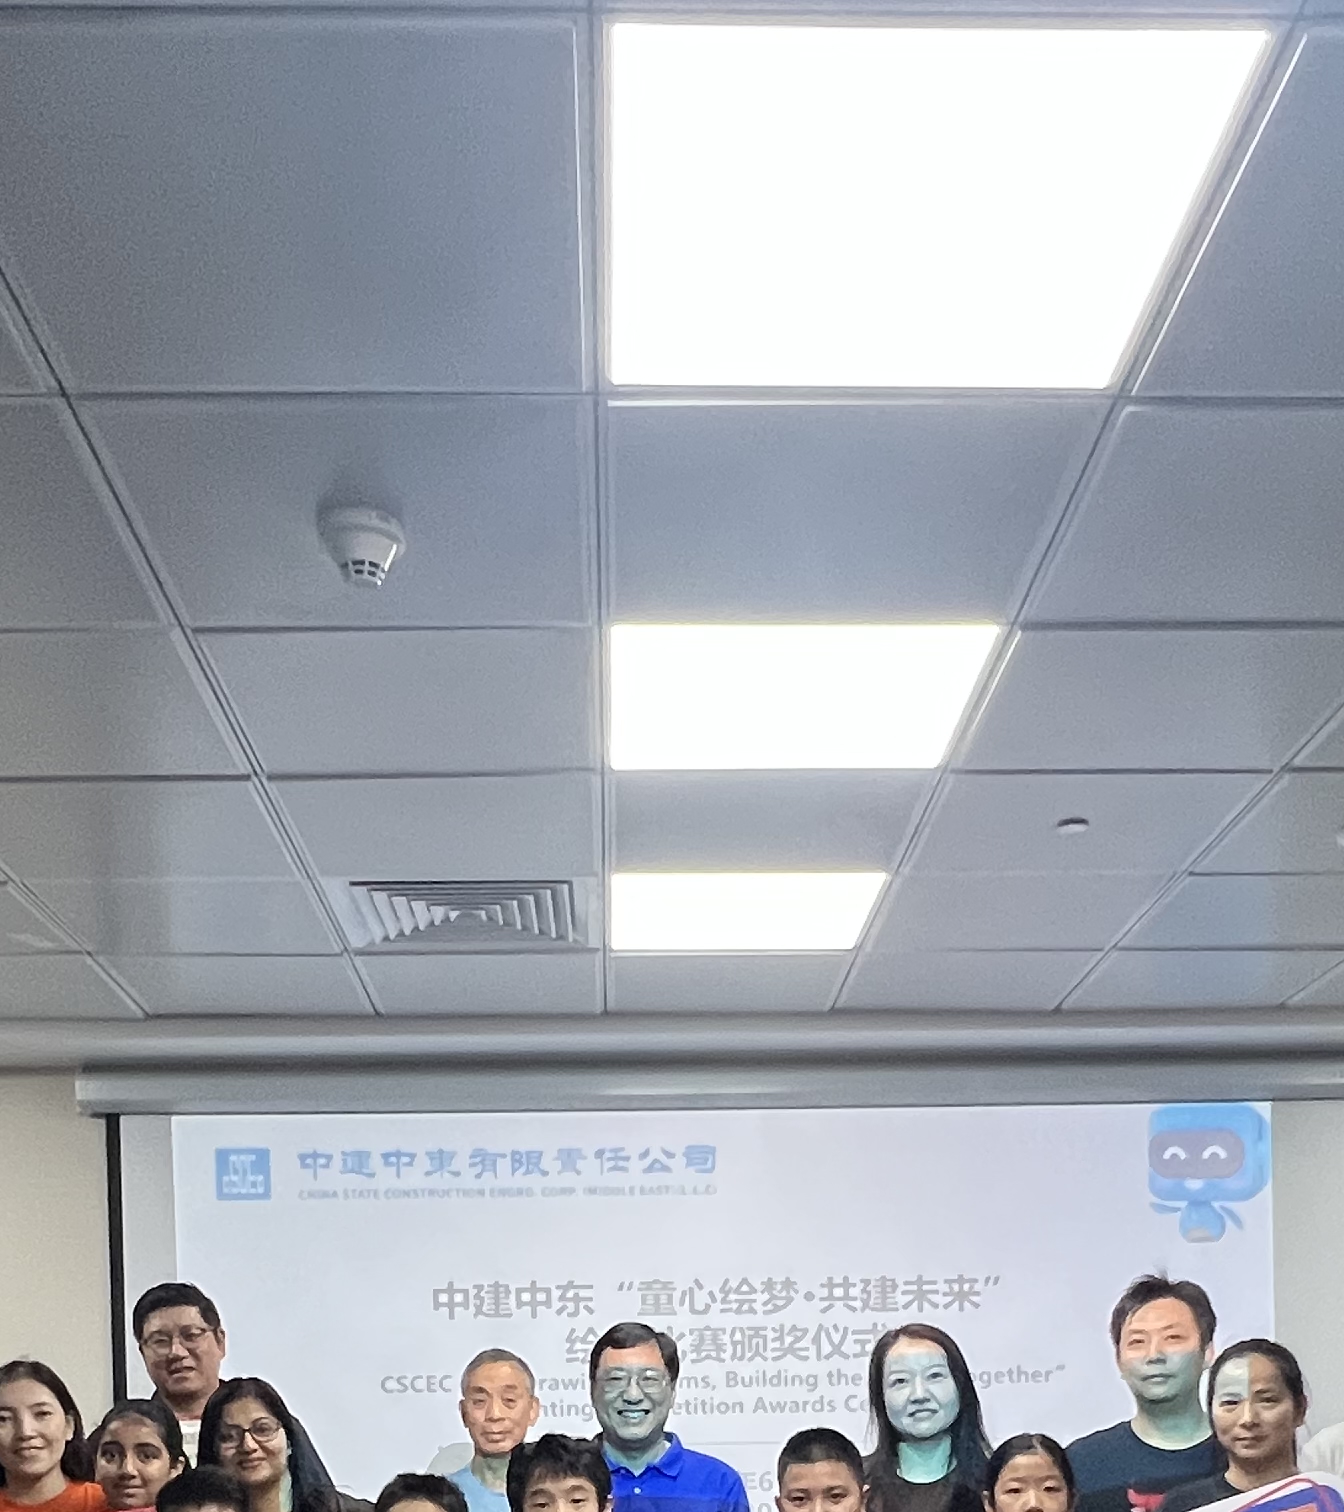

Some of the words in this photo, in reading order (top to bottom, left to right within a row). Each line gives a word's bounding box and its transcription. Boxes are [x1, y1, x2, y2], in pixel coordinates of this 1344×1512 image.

[342, 1187, 380, 1200] STATE
[383, 1186, 485, 1200] CONSTRUCTION
[380, 1374, 453, 1394] CSCEC
[725, 1368, 819, 1392] Building
[826, 1367, 863, 1388] the
[541, 1400, 594, 1422] nting
[672, 1397, 744, 1416] etition
[751, 1396, 835, 1414] Awards
